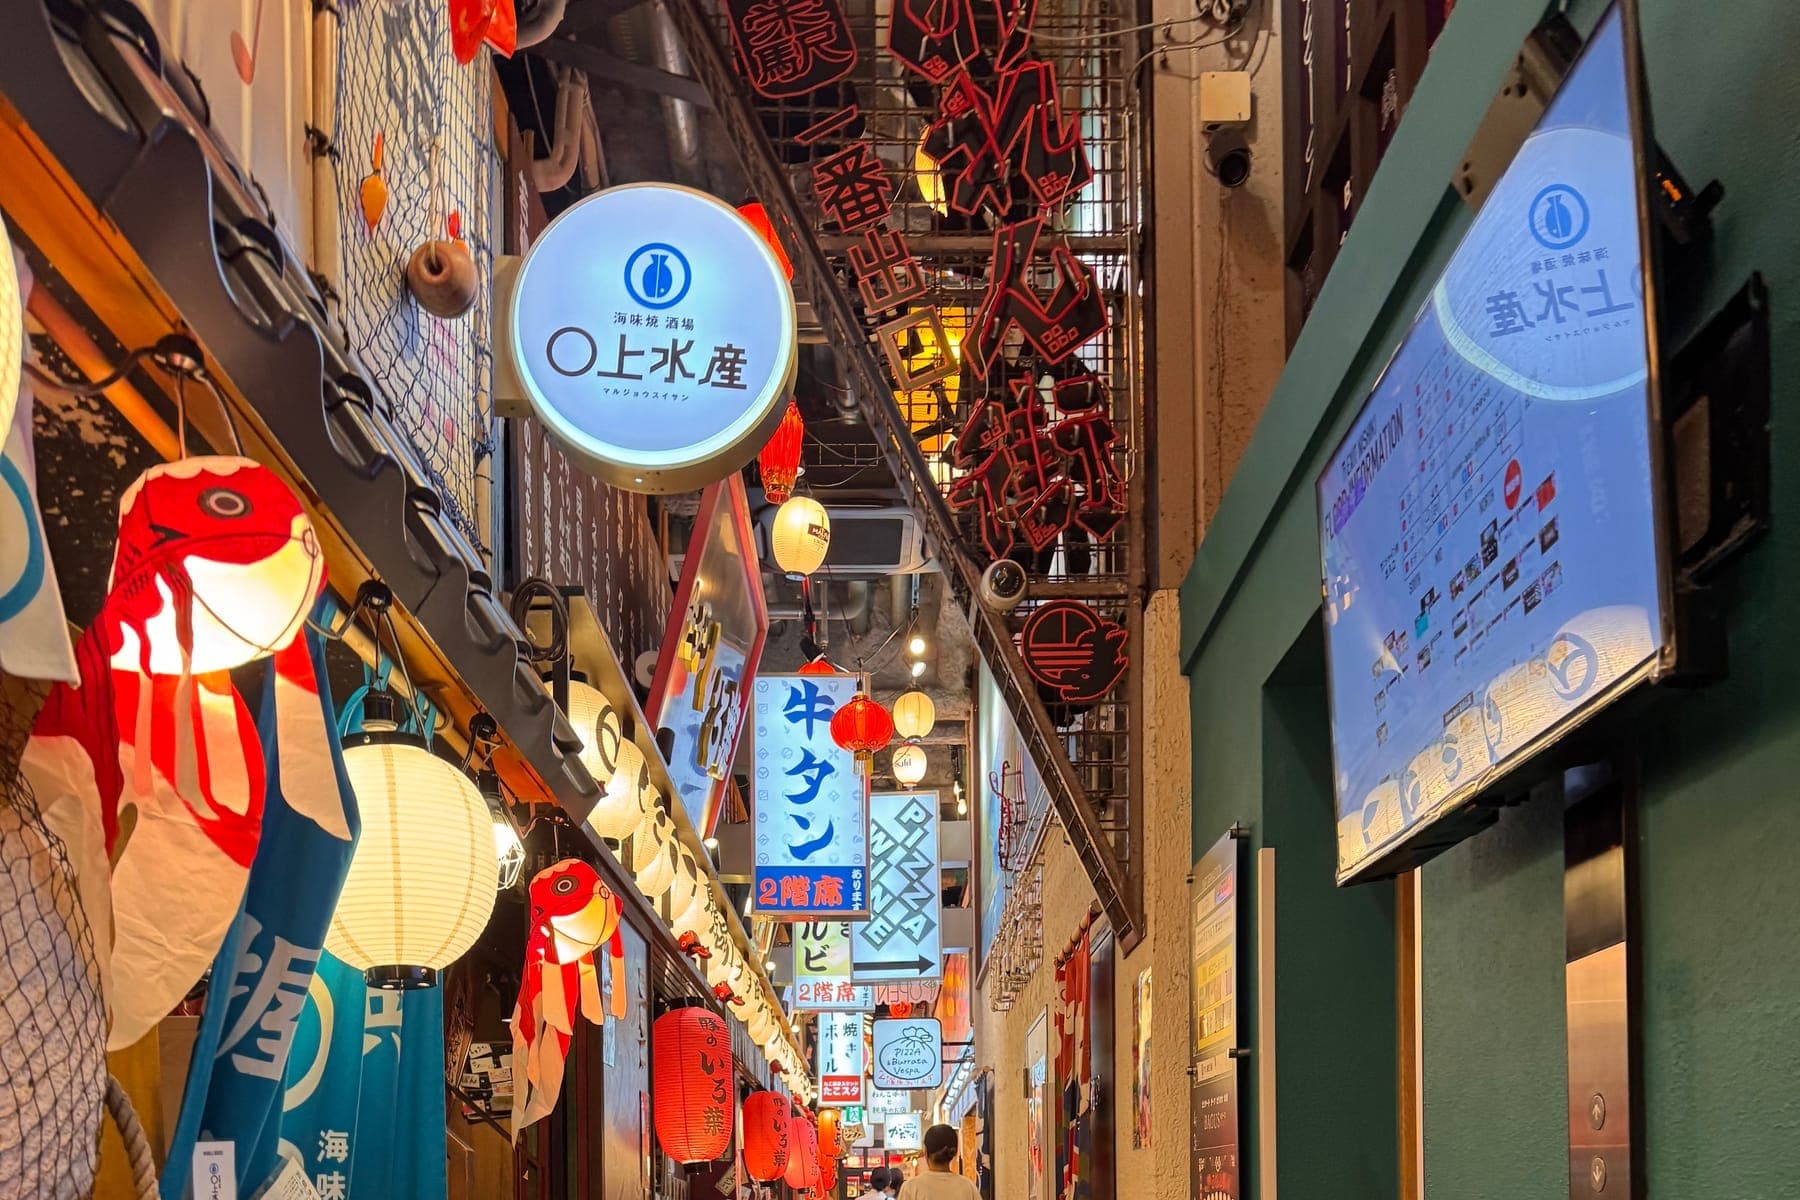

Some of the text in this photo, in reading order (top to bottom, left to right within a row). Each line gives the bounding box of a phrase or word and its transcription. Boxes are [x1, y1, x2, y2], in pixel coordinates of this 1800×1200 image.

[665, 316, 695, 331] 酒場
[602, 387, 689, 402] マルジョウスイサン
[783, 678, 836, 861] 牛タン
[758, 874, 844, 908] 2階席
[799, 980, 856, 1004] 2階席
[823, 1086, 860, 1097] たこスタ
